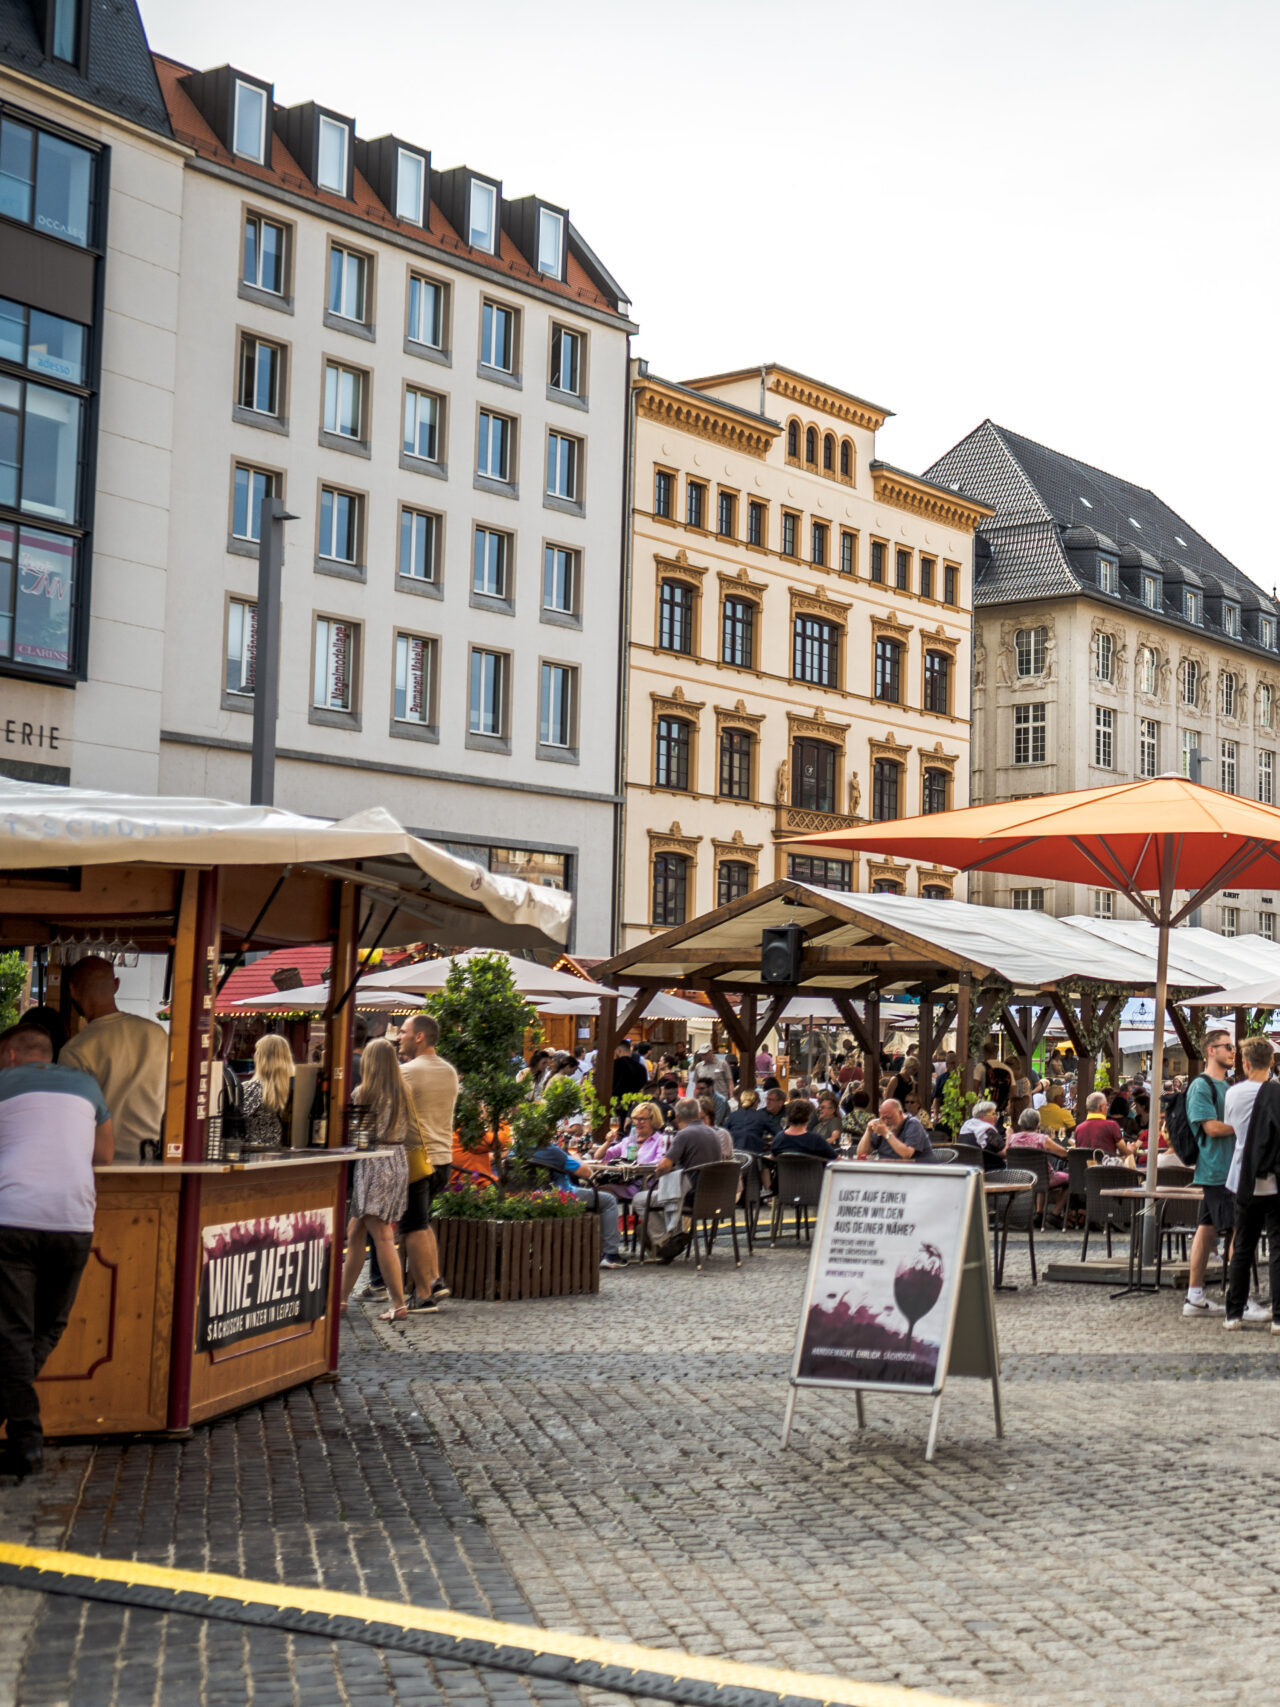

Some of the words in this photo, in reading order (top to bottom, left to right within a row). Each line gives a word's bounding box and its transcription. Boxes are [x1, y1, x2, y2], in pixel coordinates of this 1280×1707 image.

[19, 644, 69, 661] CLARINS
[331, 626, 350, 701] Nagelmodellage
[410, 672, 425, 713] Permanent
[838, 1189, 860, 1202] LUST
[861, 1190, 880, 1203] AUF
[880, 1191, 907, 1204] EINEN
[836, 1205, 869, 1218] JUNGEN
[870, 1207, 904, 1220] WILDEN
[833, 1221, 851, 1233] AUS
[852, 1222, 884, 1235] DEINER
[885, 1222, 916, 1236] NÄHE?
[209, 1251, 256, 1318] WINE
[257, 1242, 306, 1305] MEET
[308, 1238, 325, 1292] UP
[245, 1308, 267, 1330] WINZER
[268, 1306, 275, 1323] IN
[276, 1300, 300, 1321] LEIPZIG
